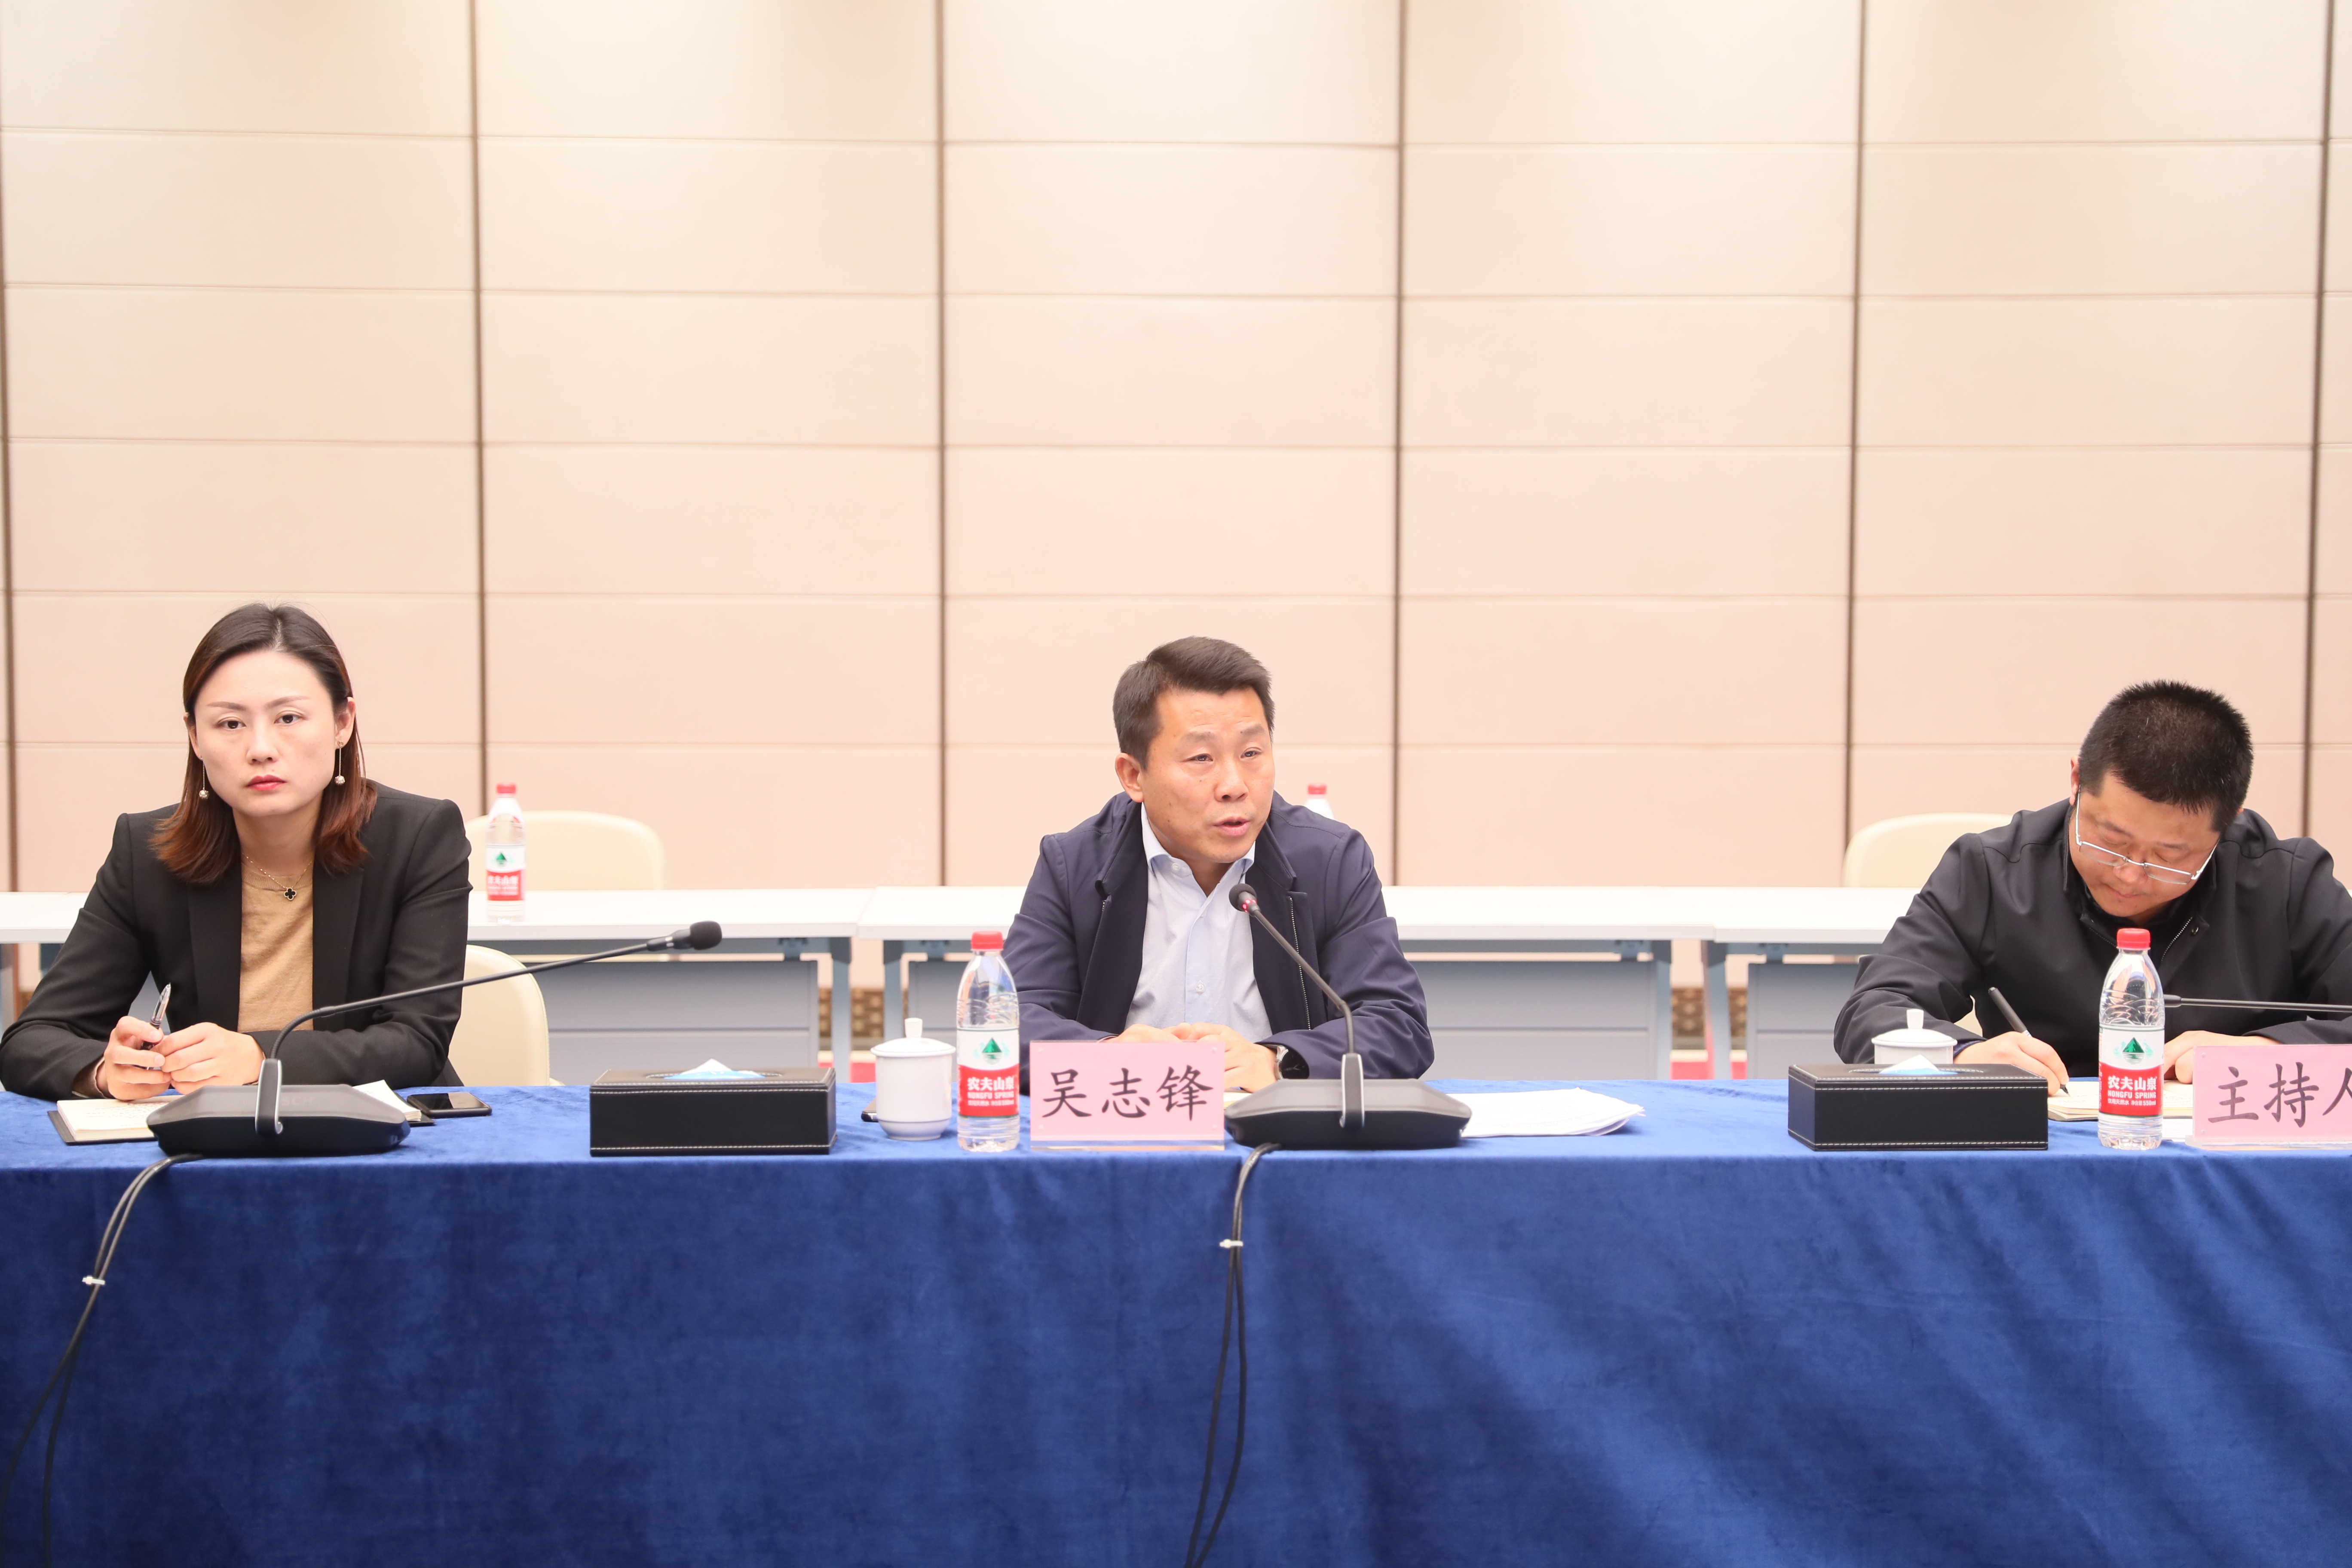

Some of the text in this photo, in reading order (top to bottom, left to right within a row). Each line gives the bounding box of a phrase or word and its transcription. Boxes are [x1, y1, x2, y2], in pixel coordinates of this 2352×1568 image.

[968, 1076, 1014, 1091] 农夫山泉
[2108, 1075, 2157, 1090] 农夫山泉
[1042, 1065, 1213, 1121] 吴志锋
[2108, 1090, 2132, 1099] NONGFU
